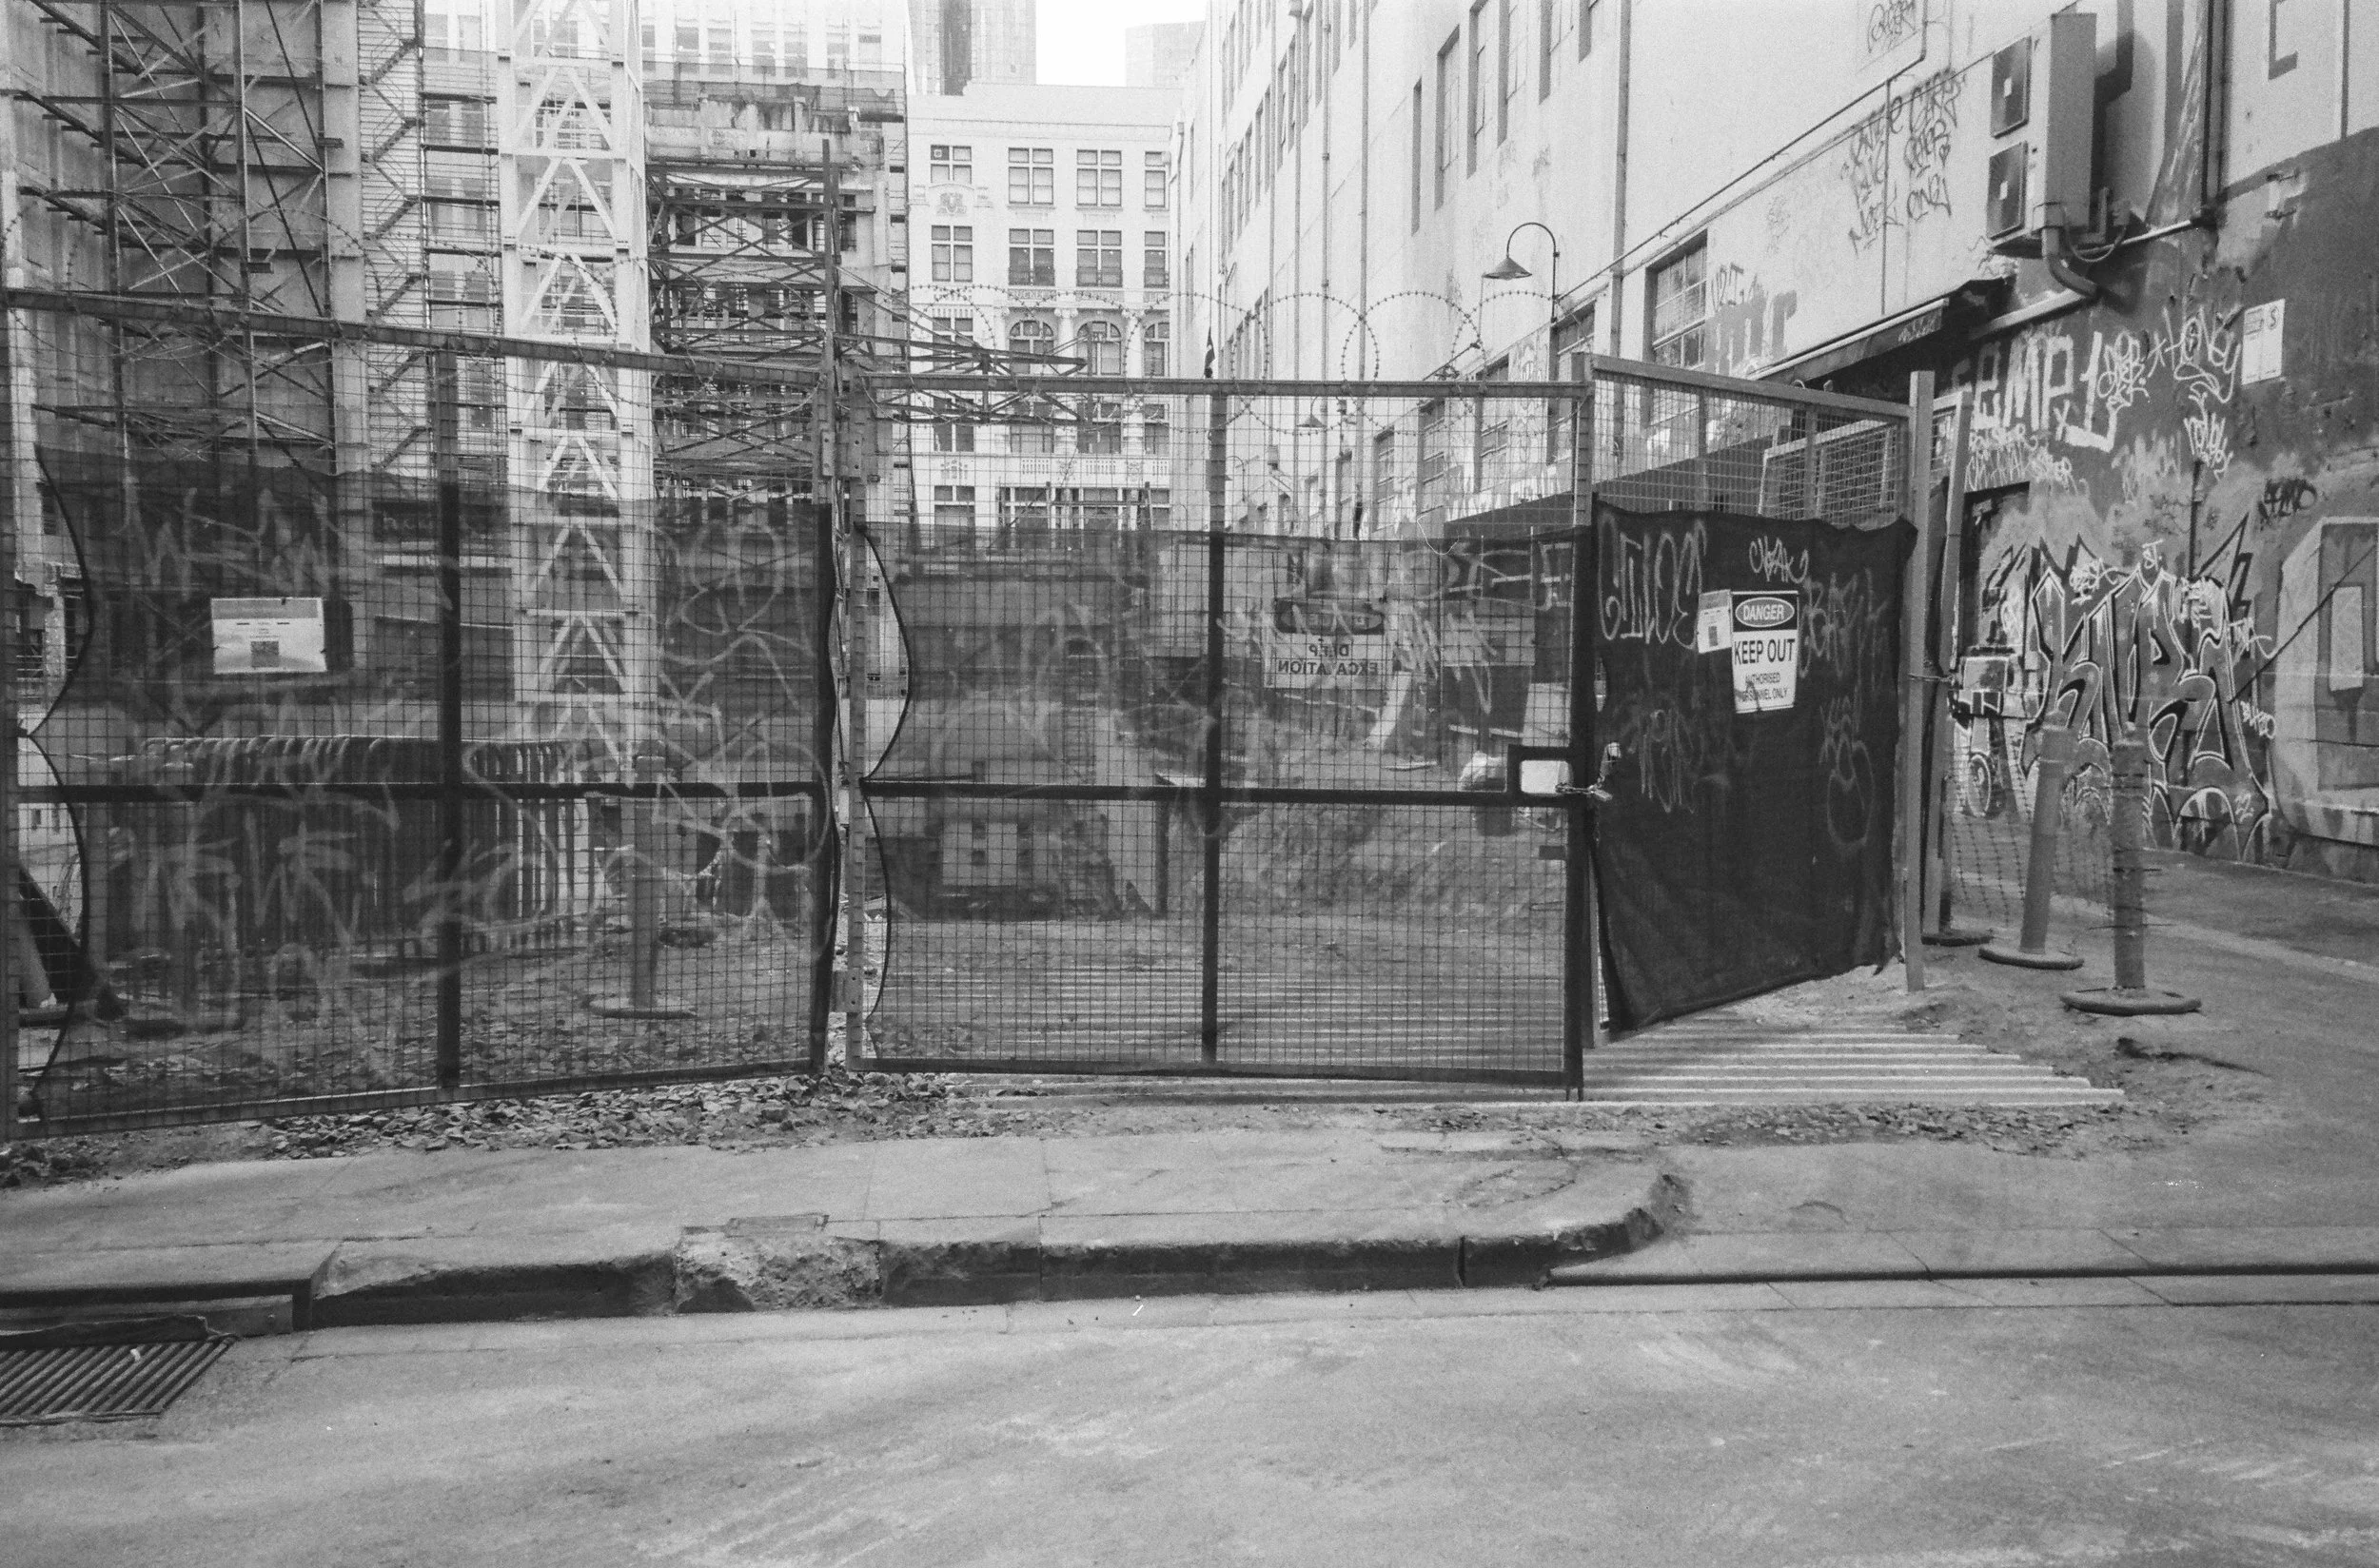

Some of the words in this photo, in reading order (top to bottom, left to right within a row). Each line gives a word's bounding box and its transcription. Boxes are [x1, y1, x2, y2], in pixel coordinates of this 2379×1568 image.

[1742, 604, 1785, 621] DANGER
[1734, 639, 1764, 665] KEEP
[1767, 638, 1796, 663] OUT
